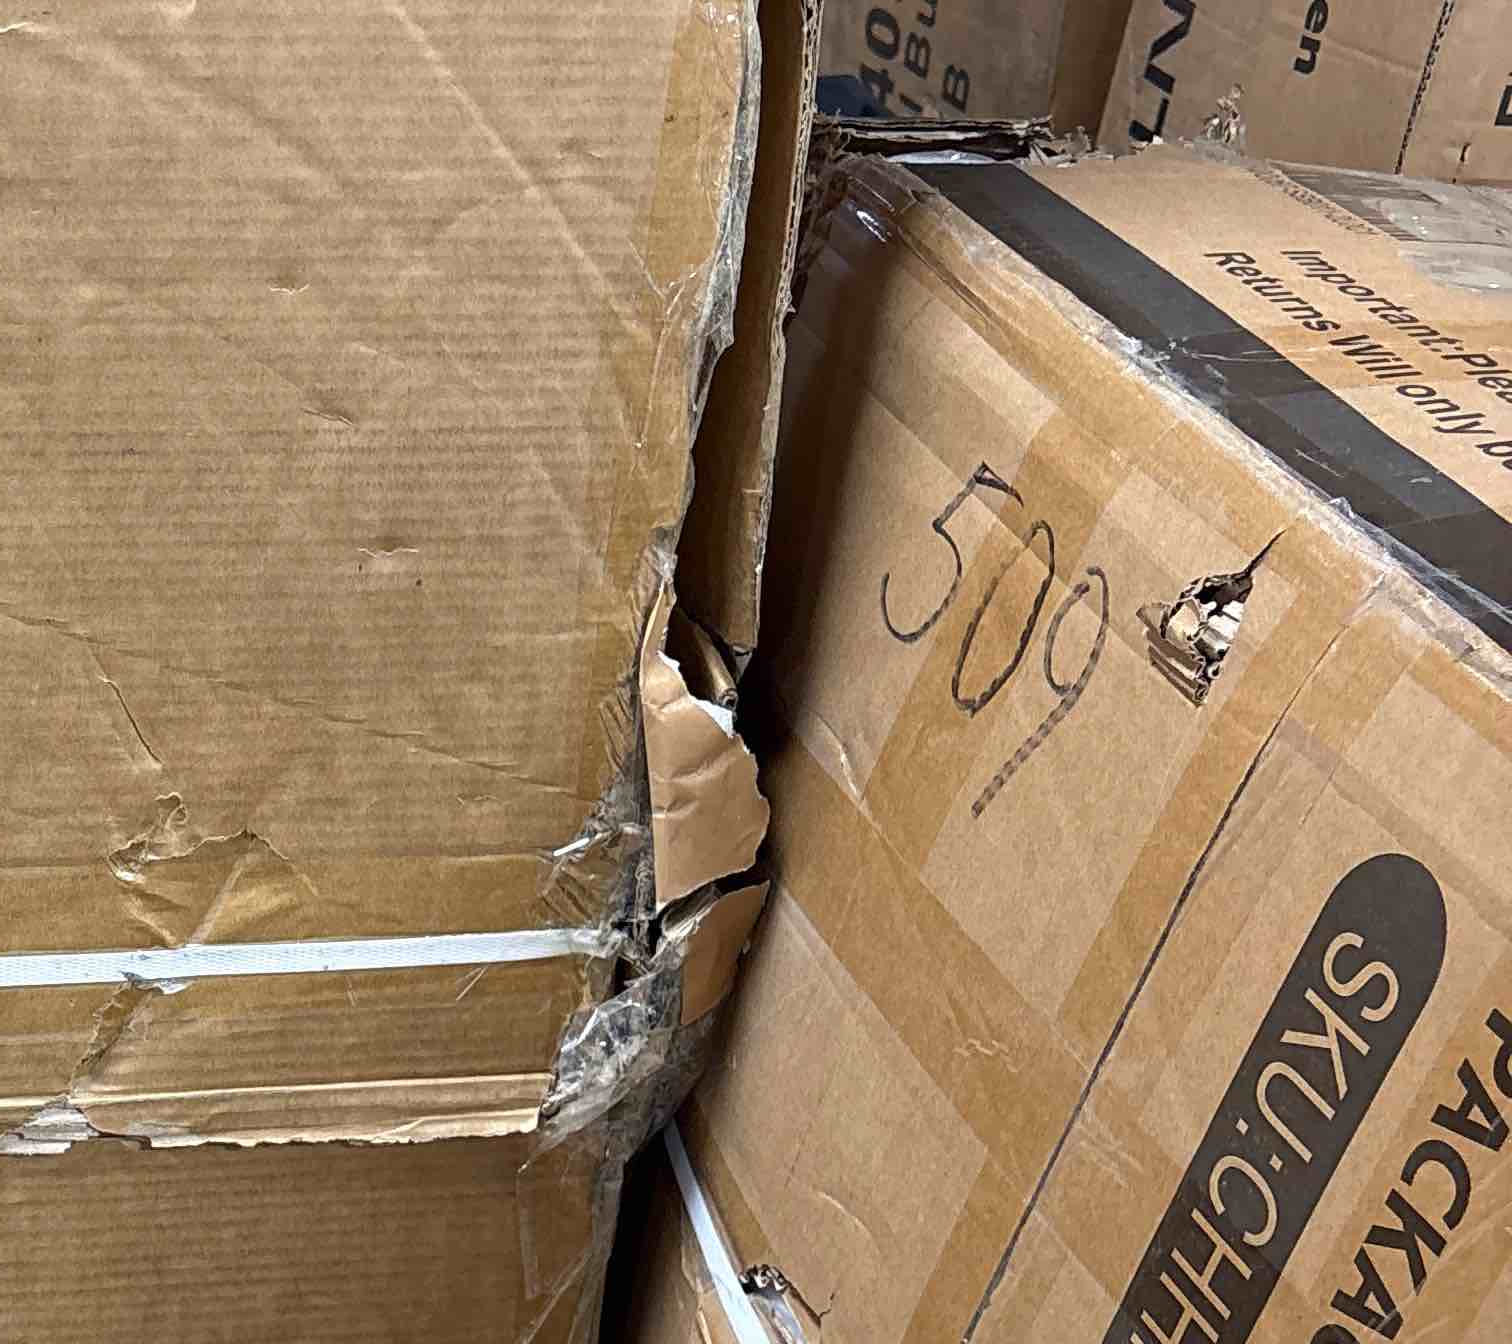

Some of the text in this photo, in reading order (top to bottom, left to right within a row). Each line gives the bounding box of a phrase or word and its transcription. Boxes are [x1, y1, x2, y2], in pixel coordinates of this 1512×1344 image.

[1203, 251, 1341, 332] Returns
[1327, 334, 1423, 379] Will
[1396, 383, 1496, 435] only
[1280, 250, 1465, 353] Important:
